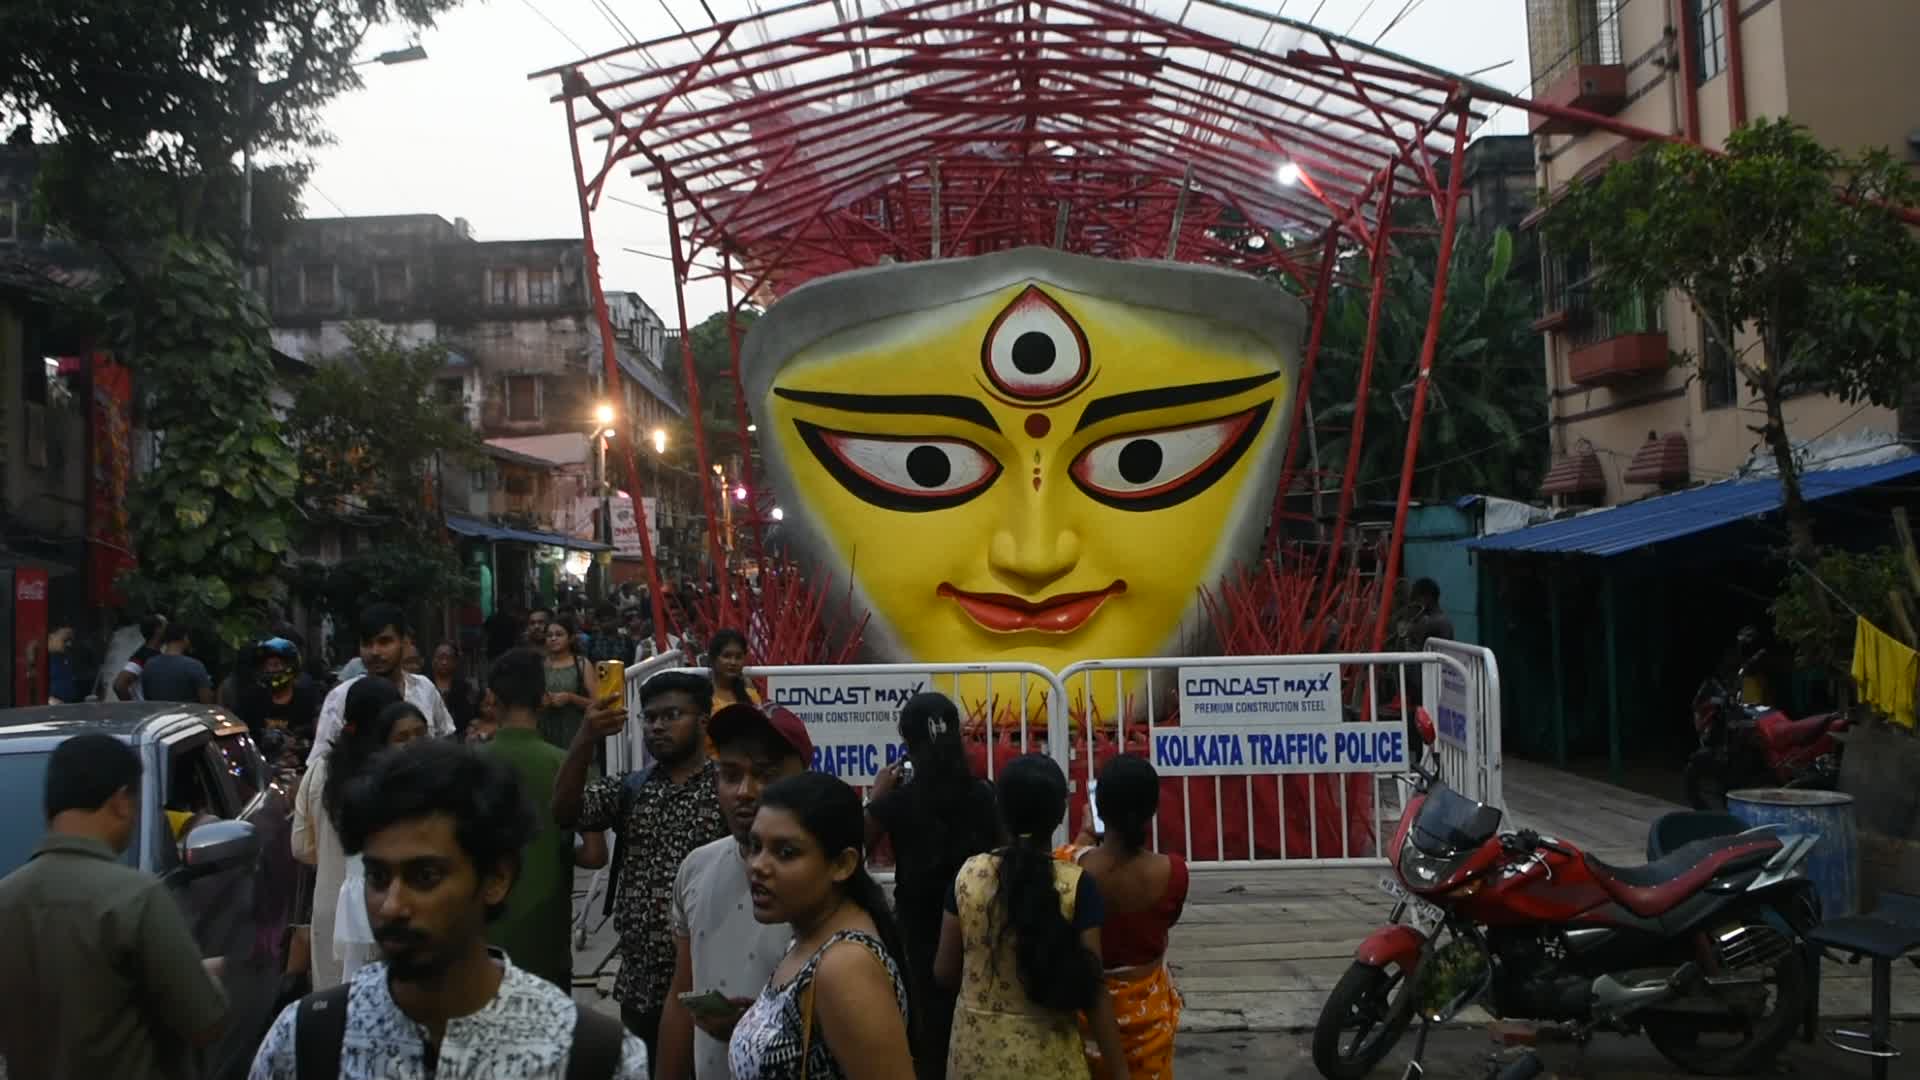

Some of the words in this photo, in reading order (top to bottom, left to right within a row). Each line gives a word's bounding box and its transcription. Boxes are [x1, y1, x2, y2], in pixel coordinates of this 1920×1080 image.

[775, 686, 871, 706] CONCAST
[1186, 677, 1281, 697] CONCAST
[1284, 672, 1333, 698] MAXX
[797, 712, 824, 724] MIUM
[825, 710, 890, 723] CONSTRUCTION
[1194, 702, 1234, 714] PREMIUM
[1235, 701, 1299, 713] CONSTRUCTION
[1301, 700, 1326, 712] STEEL
[811, 743, 879, 777] RAFFIC
[1156, 734, 1244, 767] KOLKATA
[1247, 732, 1329, 766] TRAFFIC
[1334, 731, 1403, 764] POLICE
